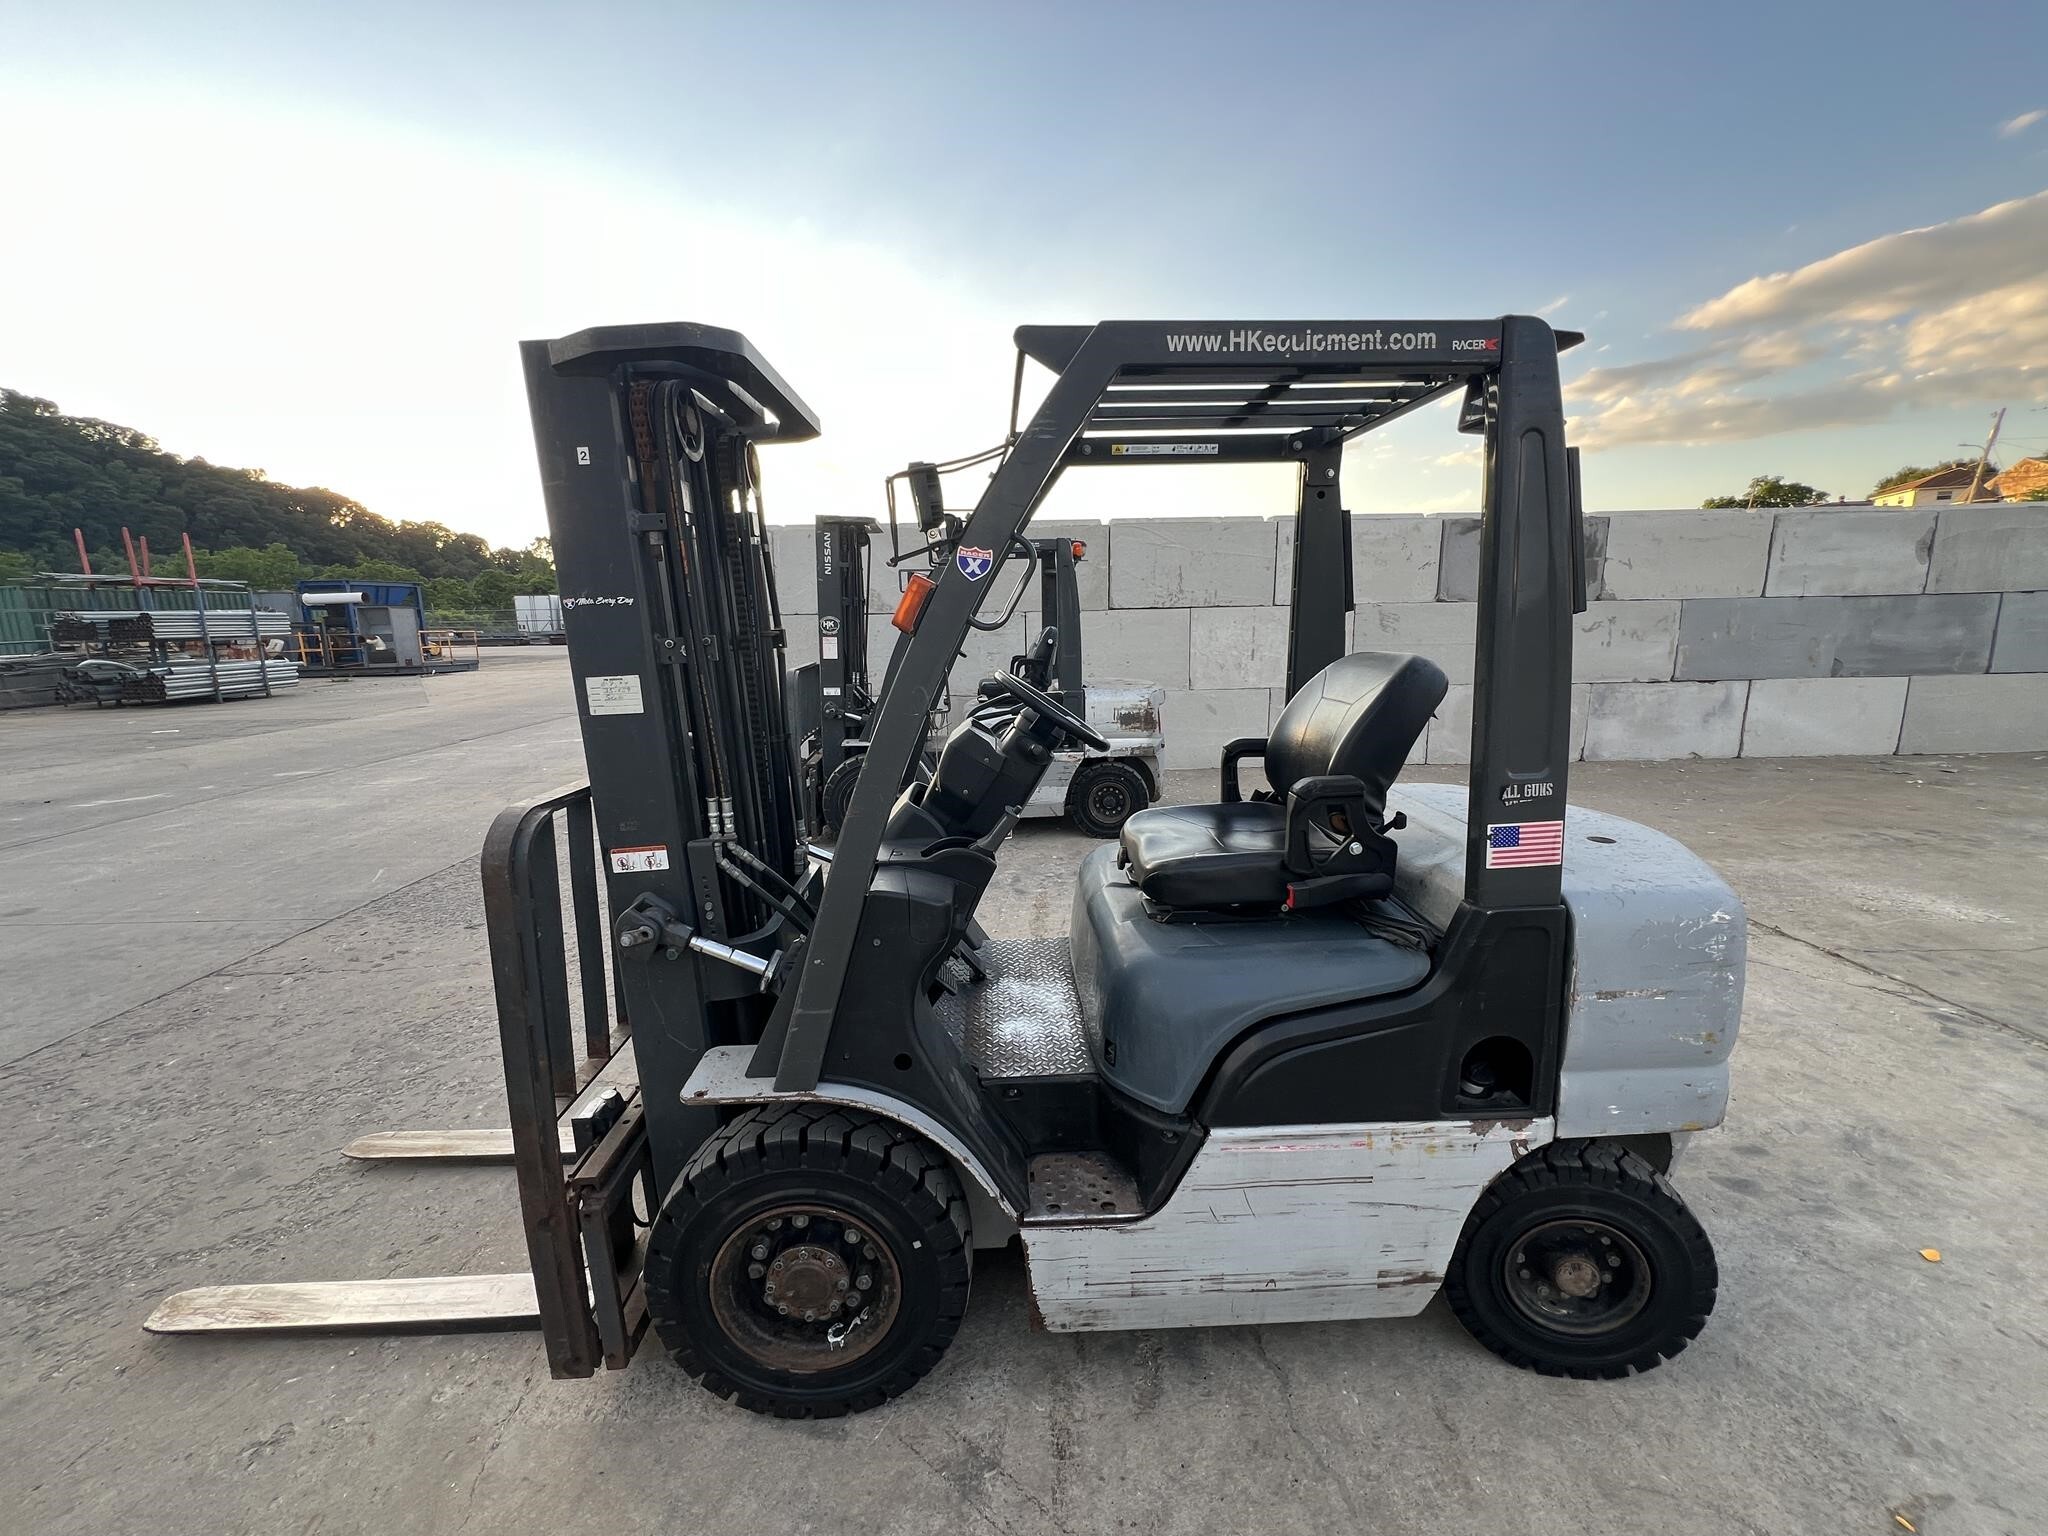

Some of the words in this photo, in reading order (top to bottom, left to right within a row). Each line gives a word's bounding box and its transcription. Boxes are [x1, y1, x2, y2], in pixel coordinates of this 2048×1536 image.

[580, 450, 588, 461] 2
[823, 532, 832, 575] NISSAN
[965, 558, 983, 574] X
